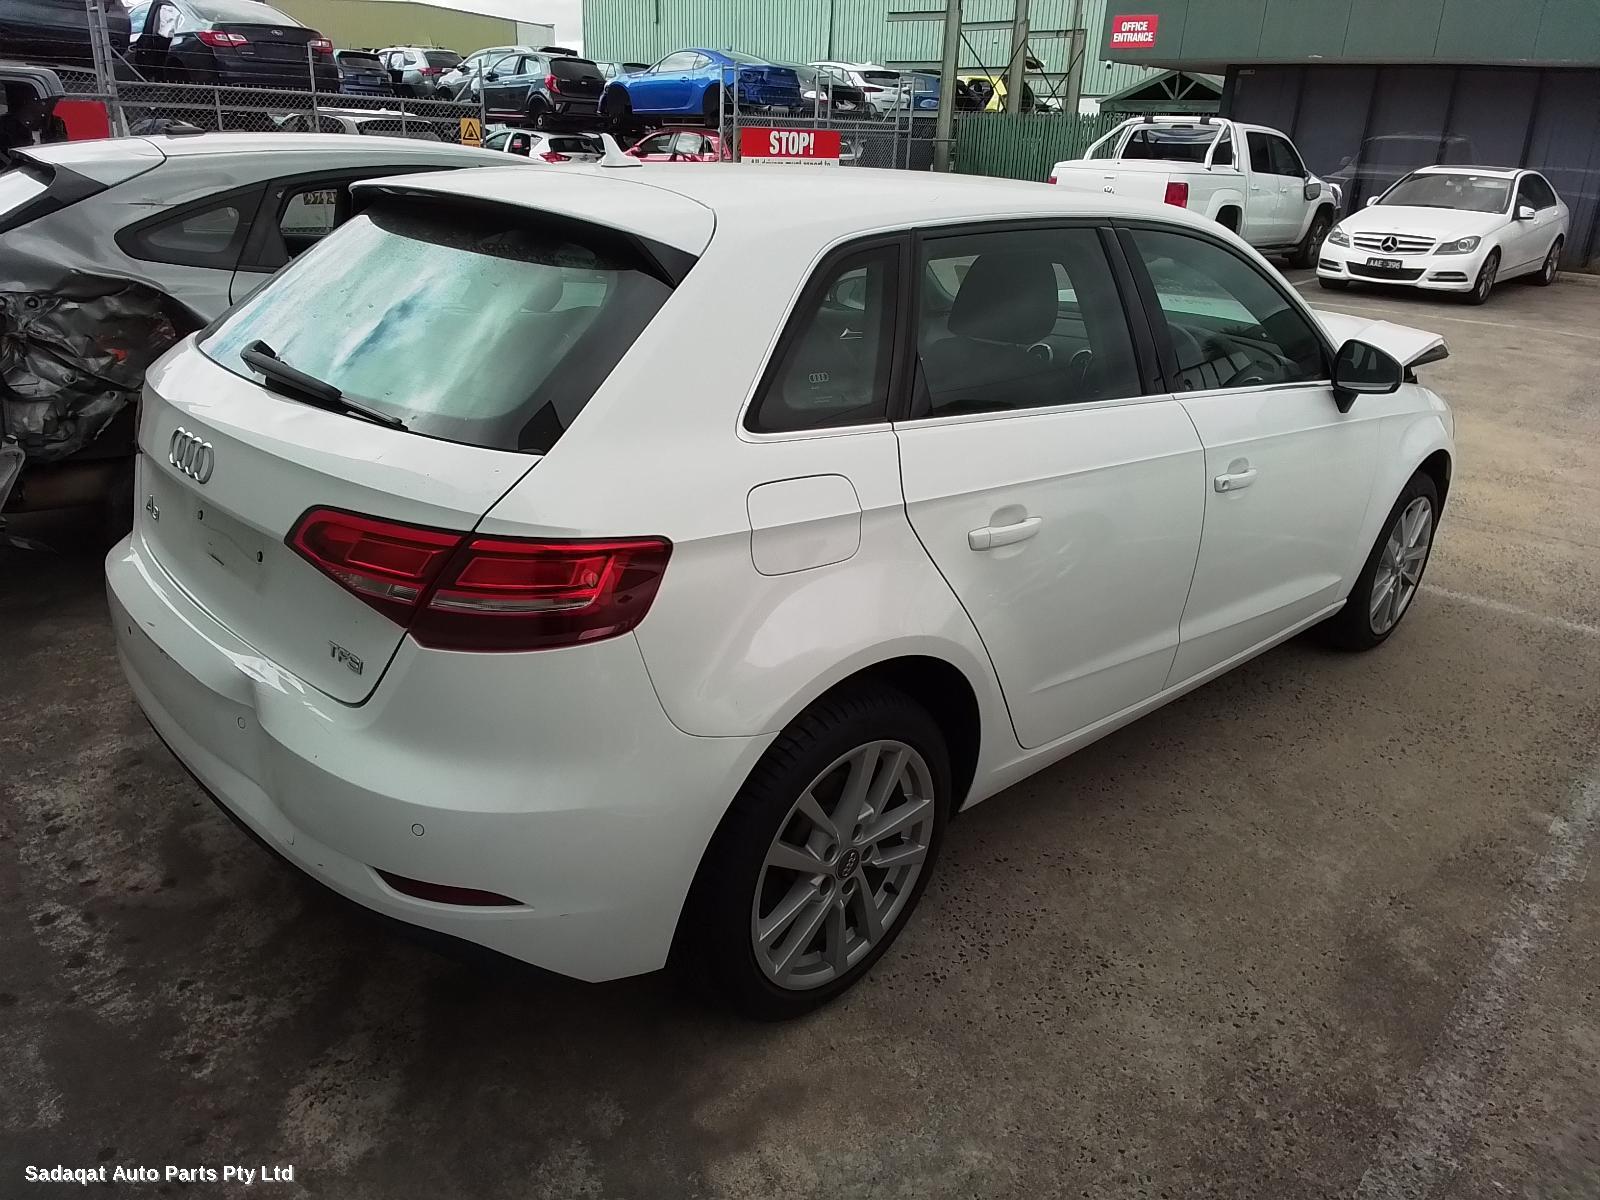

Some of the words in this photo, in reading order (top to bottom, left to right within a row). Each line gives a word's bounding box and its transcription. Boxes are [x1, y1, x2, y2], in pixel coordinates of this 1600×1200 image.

[1121, 21, 1149, 32] OFFICE
[1113, 31, 1154, 43] ENTRANCE
[769, 130, 815, 155] STOP!
[328, 639, 364, 676] TFSI
